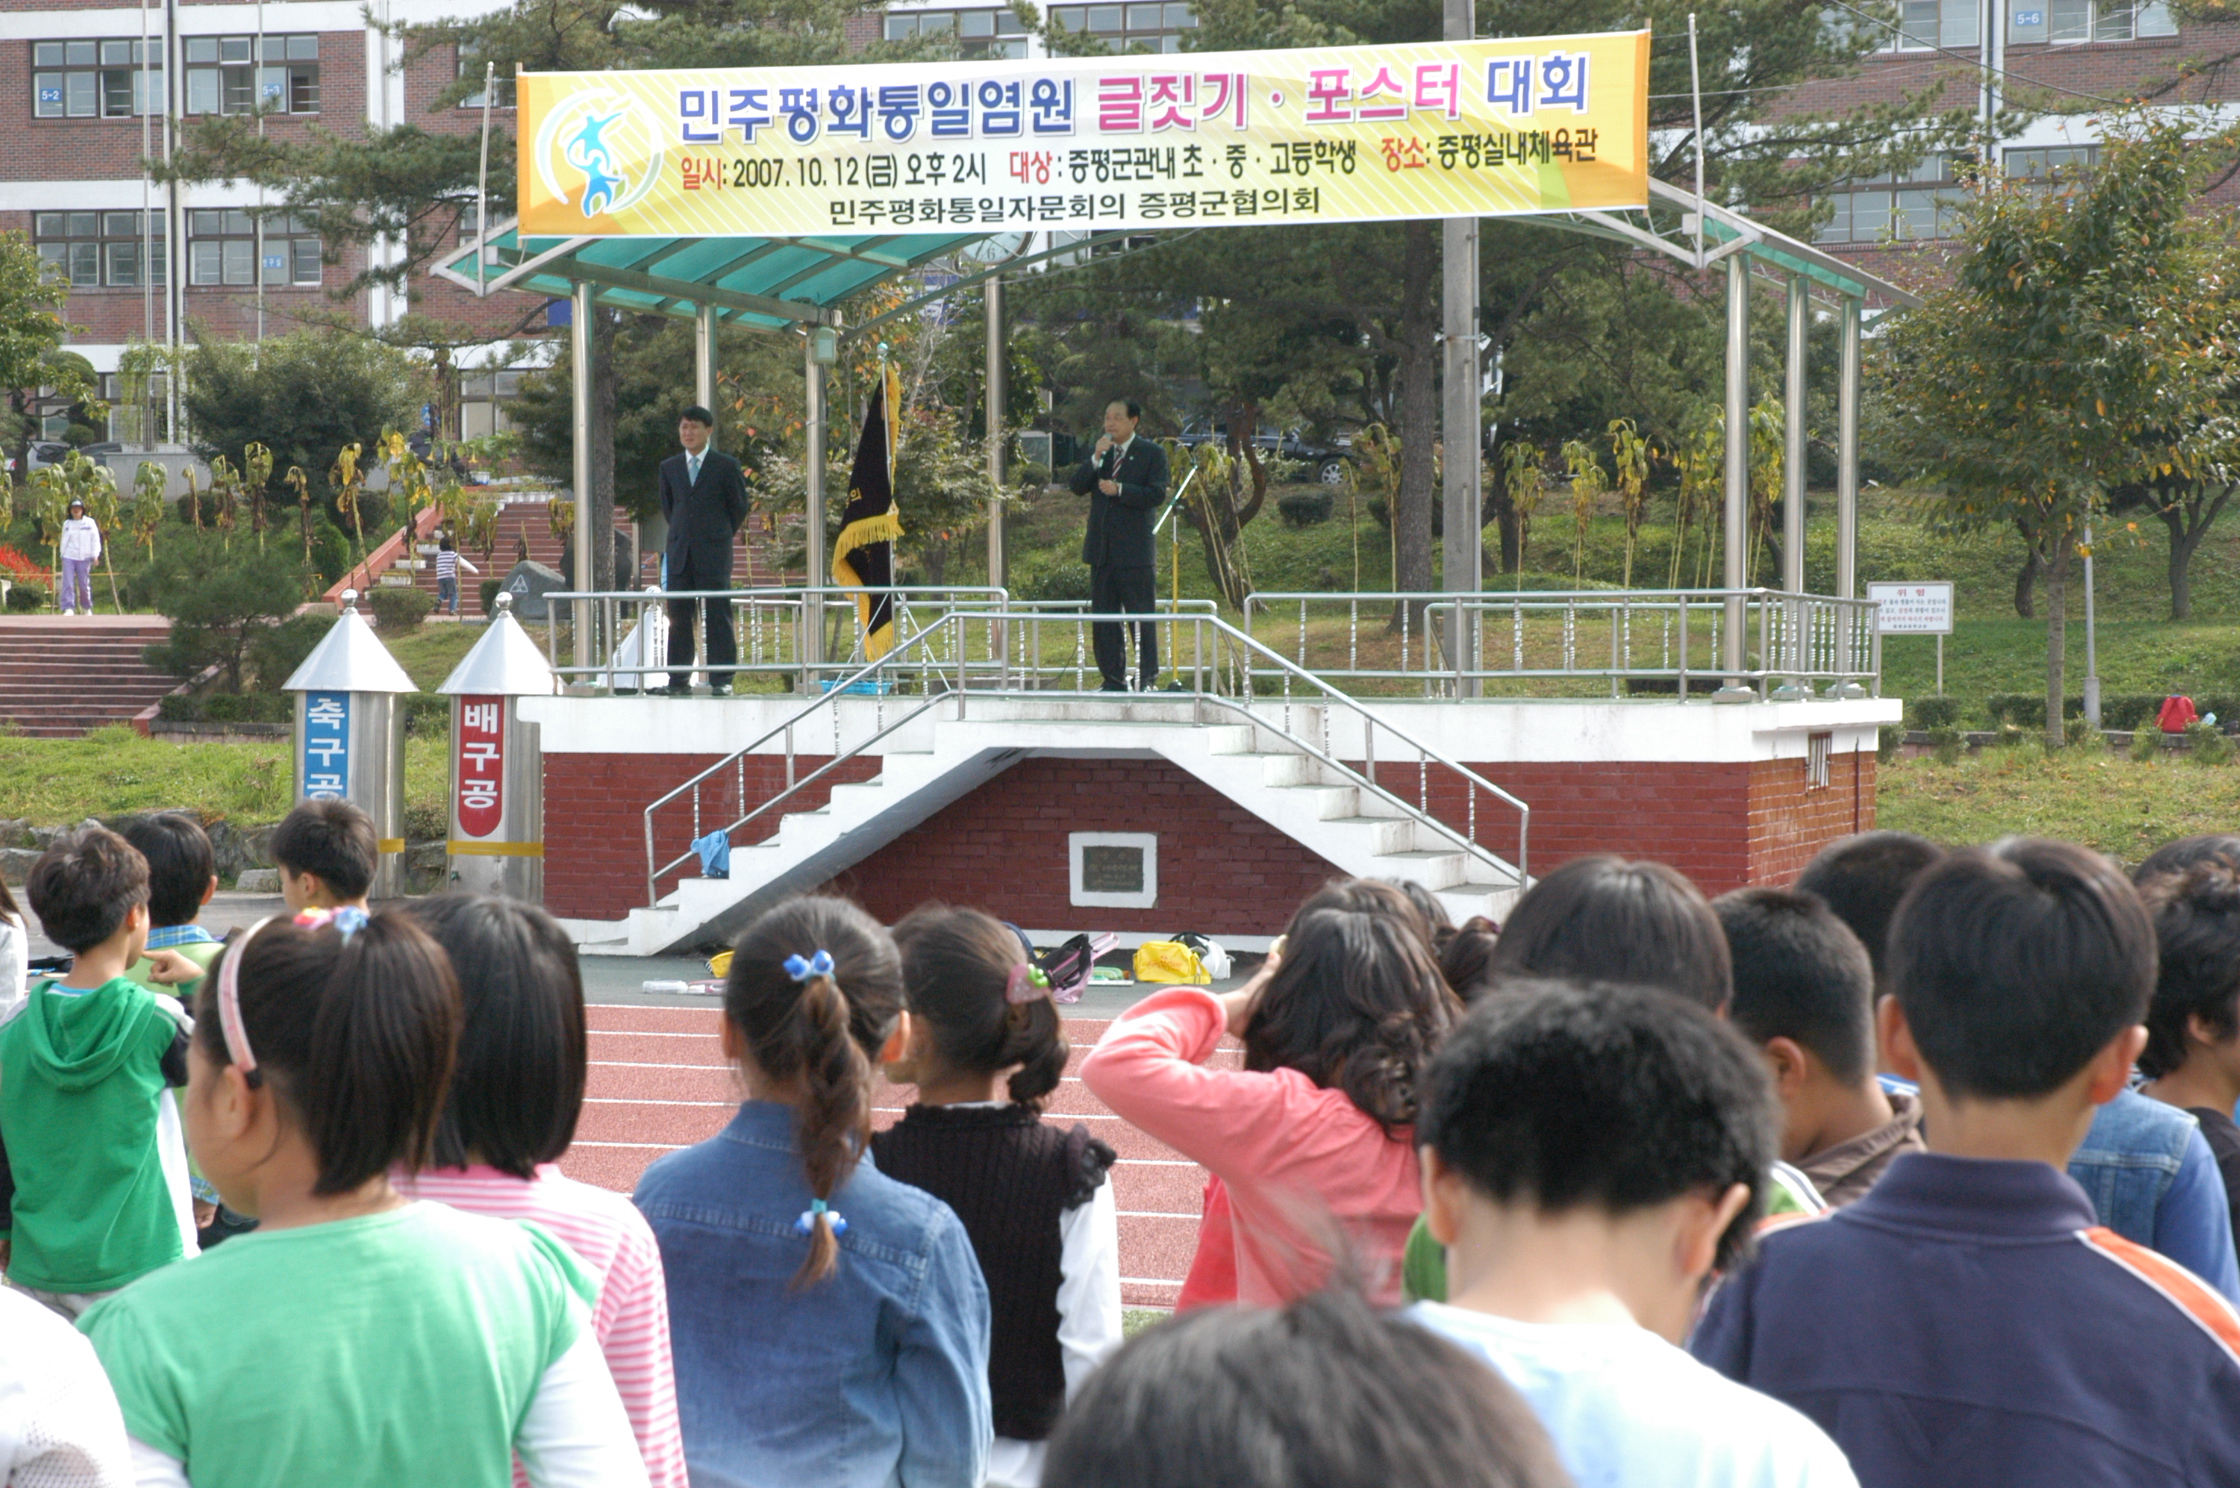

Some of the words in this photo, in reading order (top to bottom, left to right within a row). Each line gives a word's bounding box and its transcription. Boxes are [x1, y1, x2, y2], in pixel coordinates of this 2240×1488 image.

[2017, 12, 2040, 25] 5-6
[41, 90, 60, 101] 5-2
[679, 77, 1073, 143] 민주평화통일염원
[1487, 54, 1586, 114] 대회
[1068, 146, 1176, 184] 증평군관내
[1437, 127, 1598, 170] 증평실내체육관
[829, 193, 1126, 226] 민주평화통일자문회의
[1138, 186, 1320, 219] 증평군협의회
[306, 696, 346, 799] 축구공
[460, 701, 501, 810] 배구공
